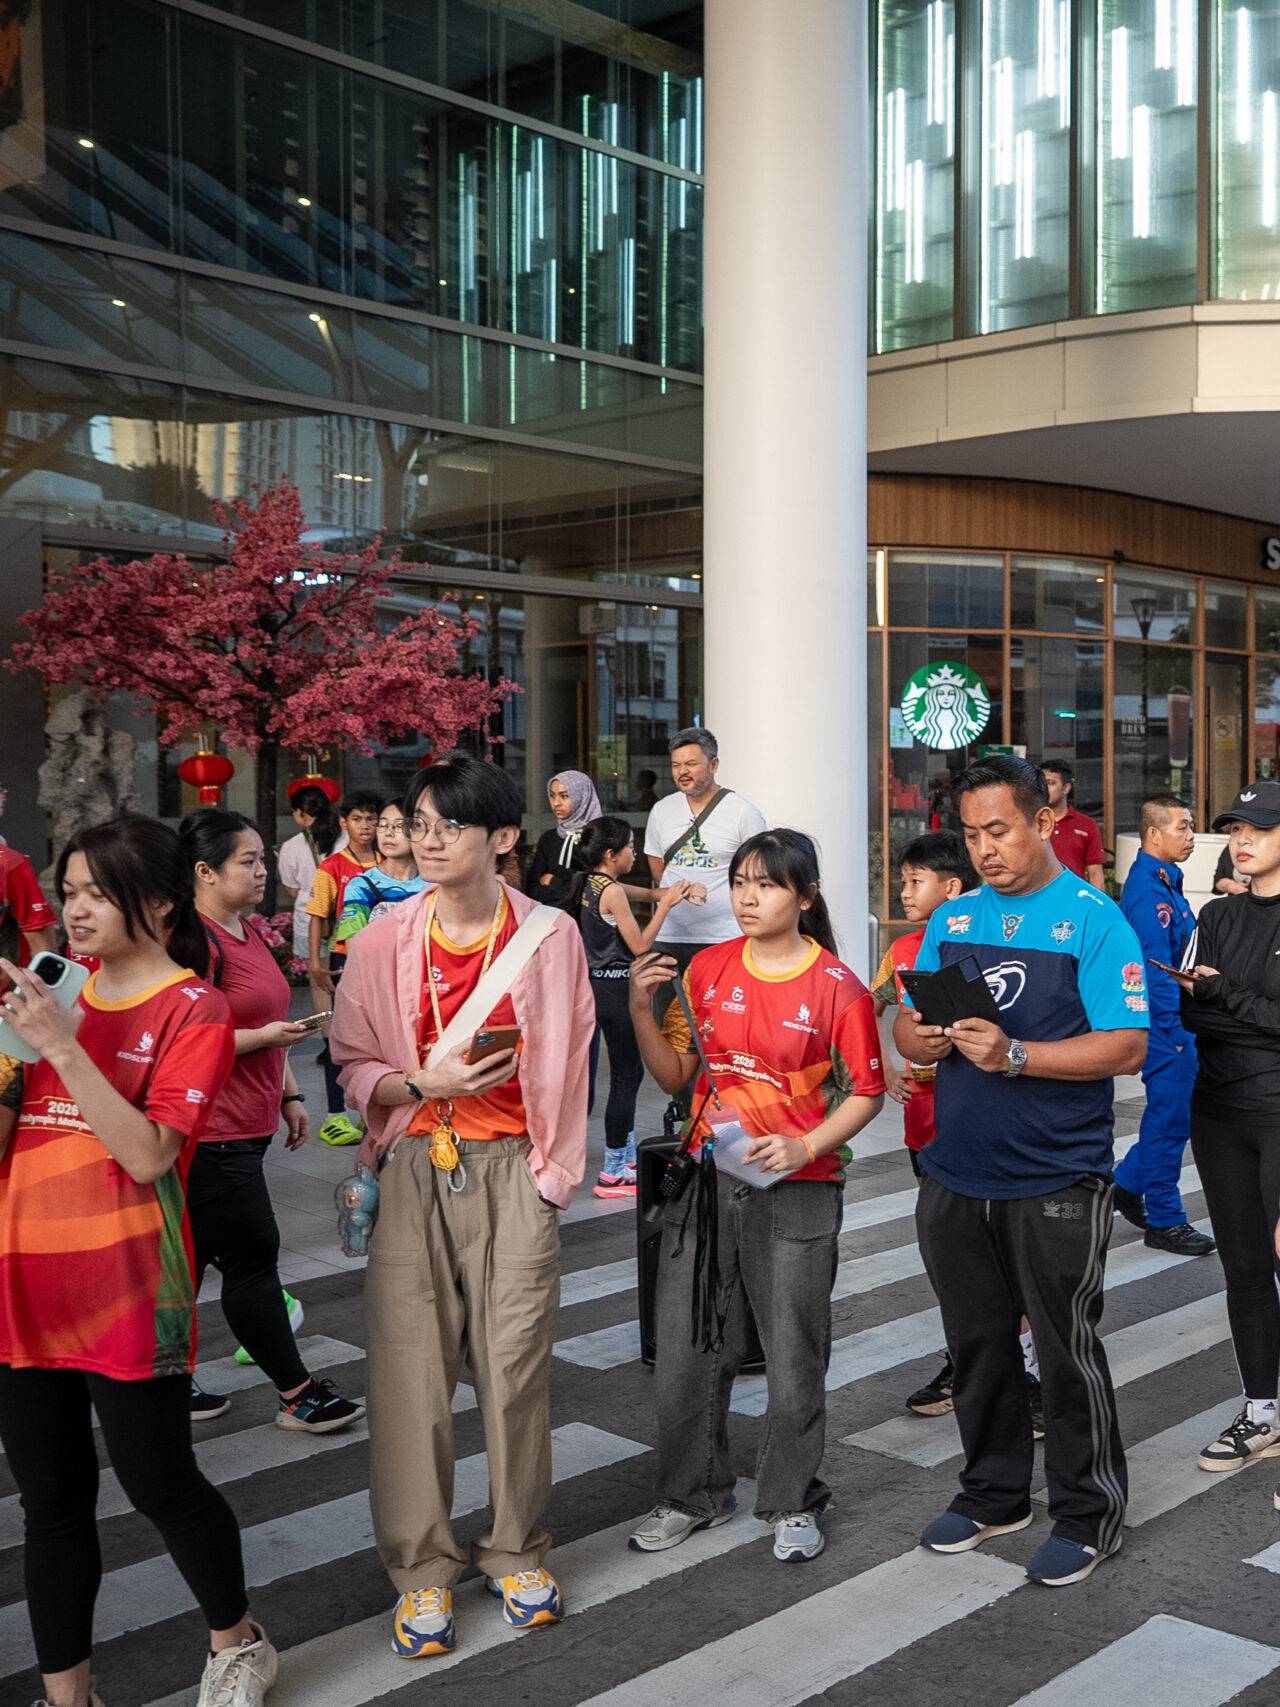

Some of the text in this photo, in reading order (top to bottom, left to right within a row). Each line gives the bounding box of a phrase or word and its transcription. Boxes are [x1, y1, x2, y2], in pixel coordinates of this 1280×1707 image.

[1121, 724, 1146, 735] BREW
[667, 853, 718, 868] didas
[604, 969, 631, 979] NIK
[732, 1054, 756, 1069] 2026
[47, 1100, 79, 1116] 2026
[1061, 1202, 1084, 1220] 33
